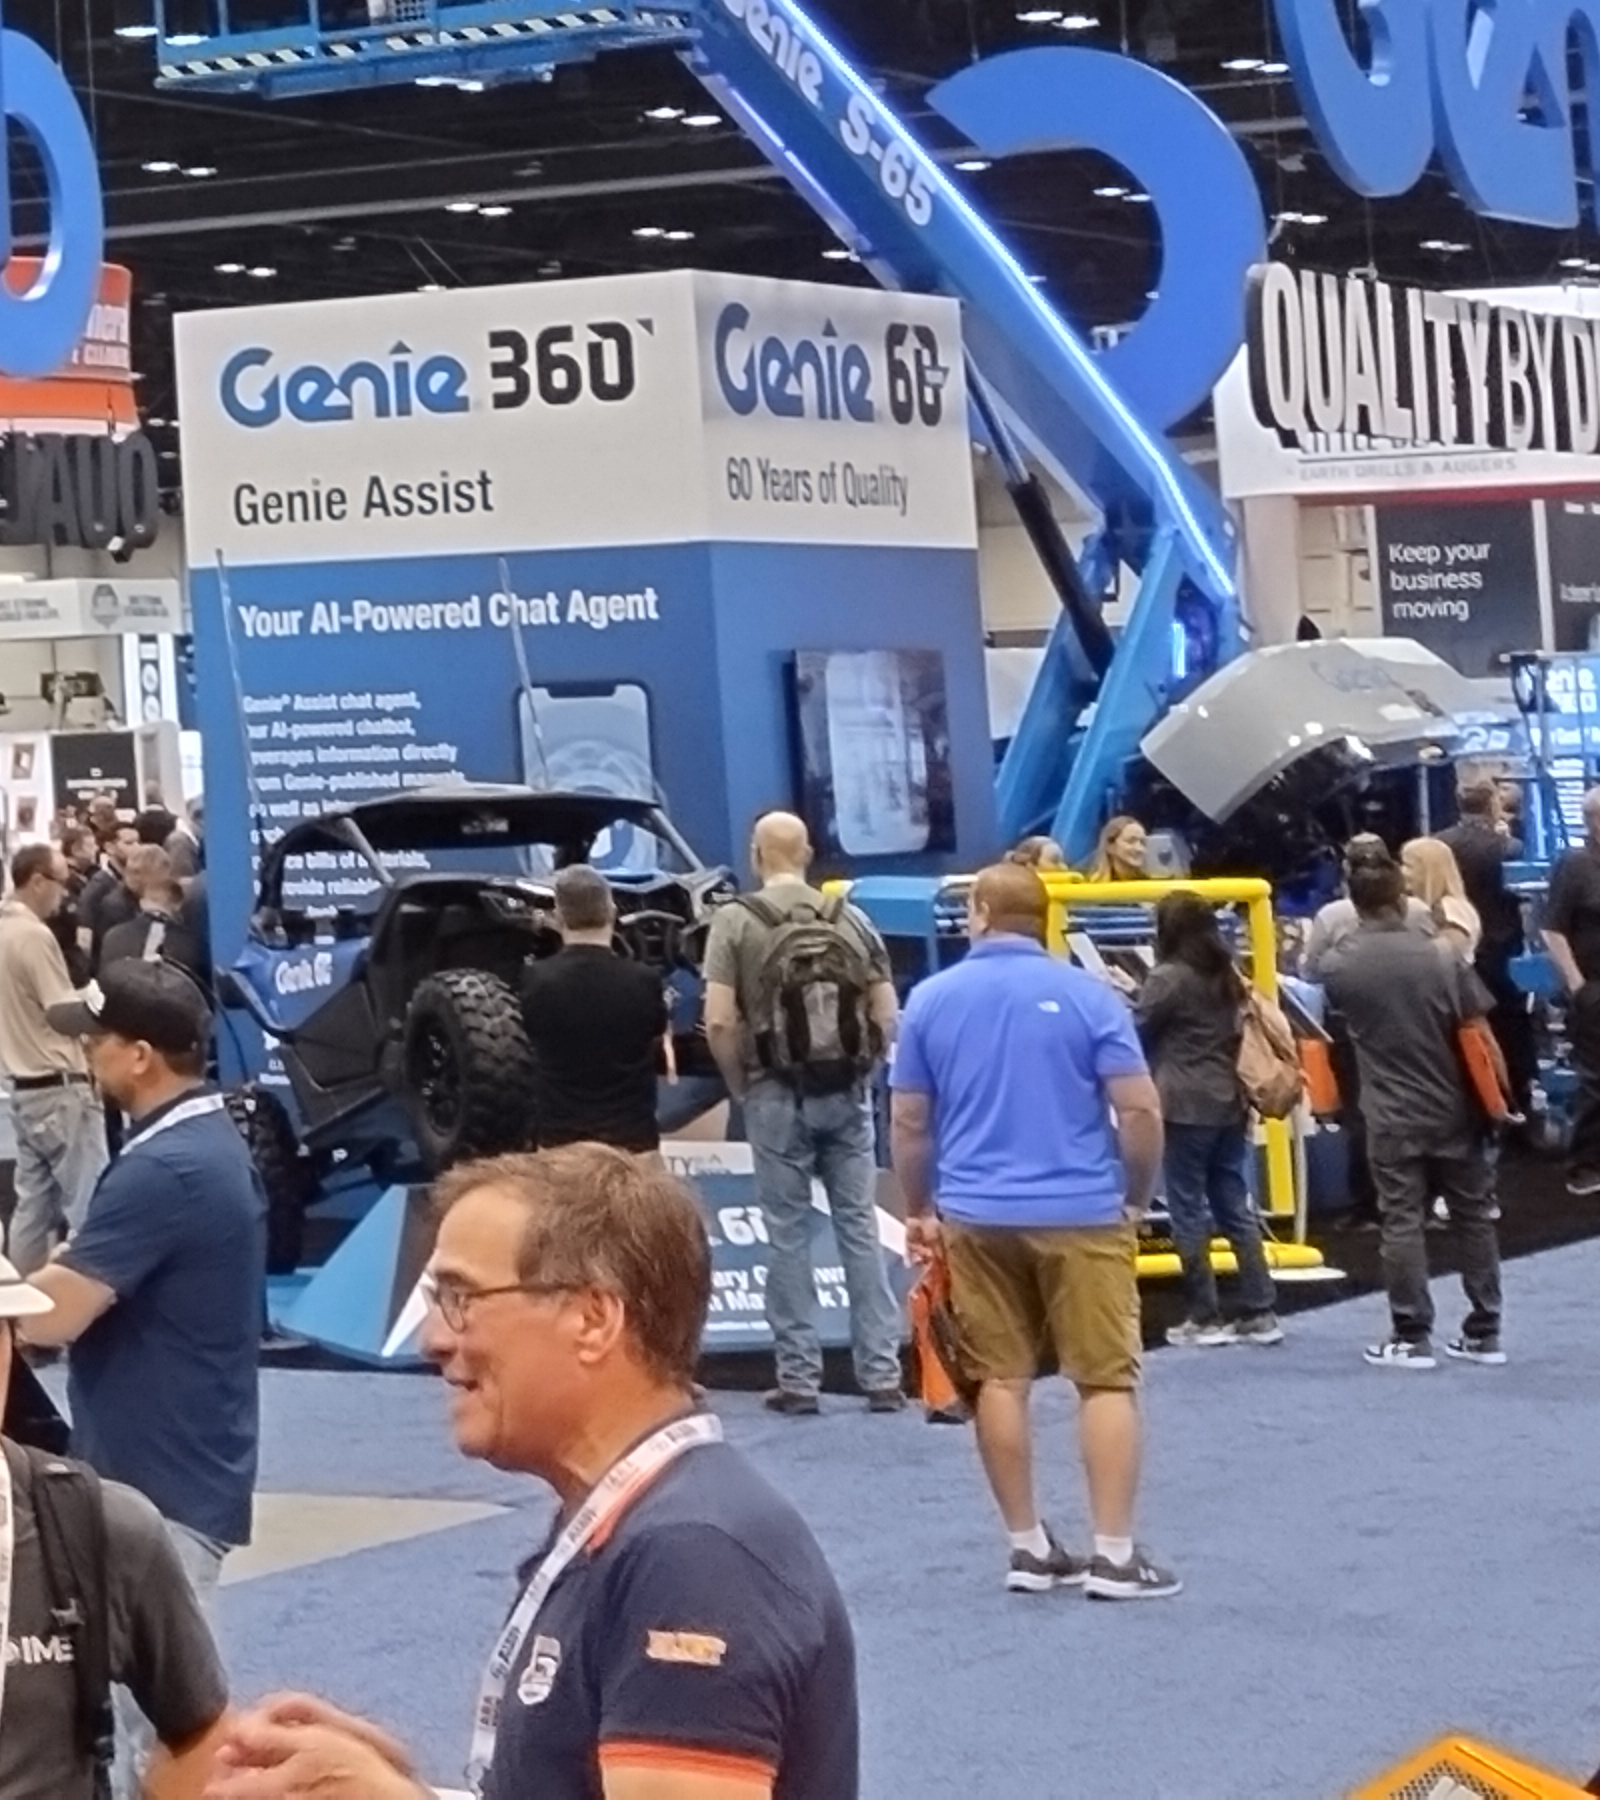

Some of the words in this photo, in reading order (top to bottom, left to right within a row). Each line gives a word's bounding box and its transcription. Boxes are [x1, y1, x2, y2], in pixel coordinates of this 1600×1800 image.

[839, 94, 935, 227] S-65
[219, 341, 469, 428] Genie
[489, 321, 639, 409] 360
[715, 301, 875, 423] Genie
[1262, 262, 1489, 450] QUALITY
[1500, 307, 1557, 452] BY
[727, 460, 753, 502] 60
[758, 461, 813, 505] Years
[818, 463, 839, 506] of
[842, 464, 909, 517] Quality
[1355, 462, 1416, 479] DRILLS
[1441, 458, 1518, 476] AUGERS
[234, 483, 349, 527] Genie
[363, 470, 493, 519] Assist
[1389, 543, 1441, 567] Keep
[1444, 544, 1491, 568] your
[1390, 570, 1483, 591] business
[239, 603, 304, 638] Your
[310, 597, 482, 636] AI-Powered
[488, 594, 561, 629] Chat
[566, 588, 660, 631] Agent
[1393, 599, 1469, 623] moving
[294, 693, 338, 711] Assist
[340, 692, 372, 710] chat
[250, 749, 315, 767] everages
